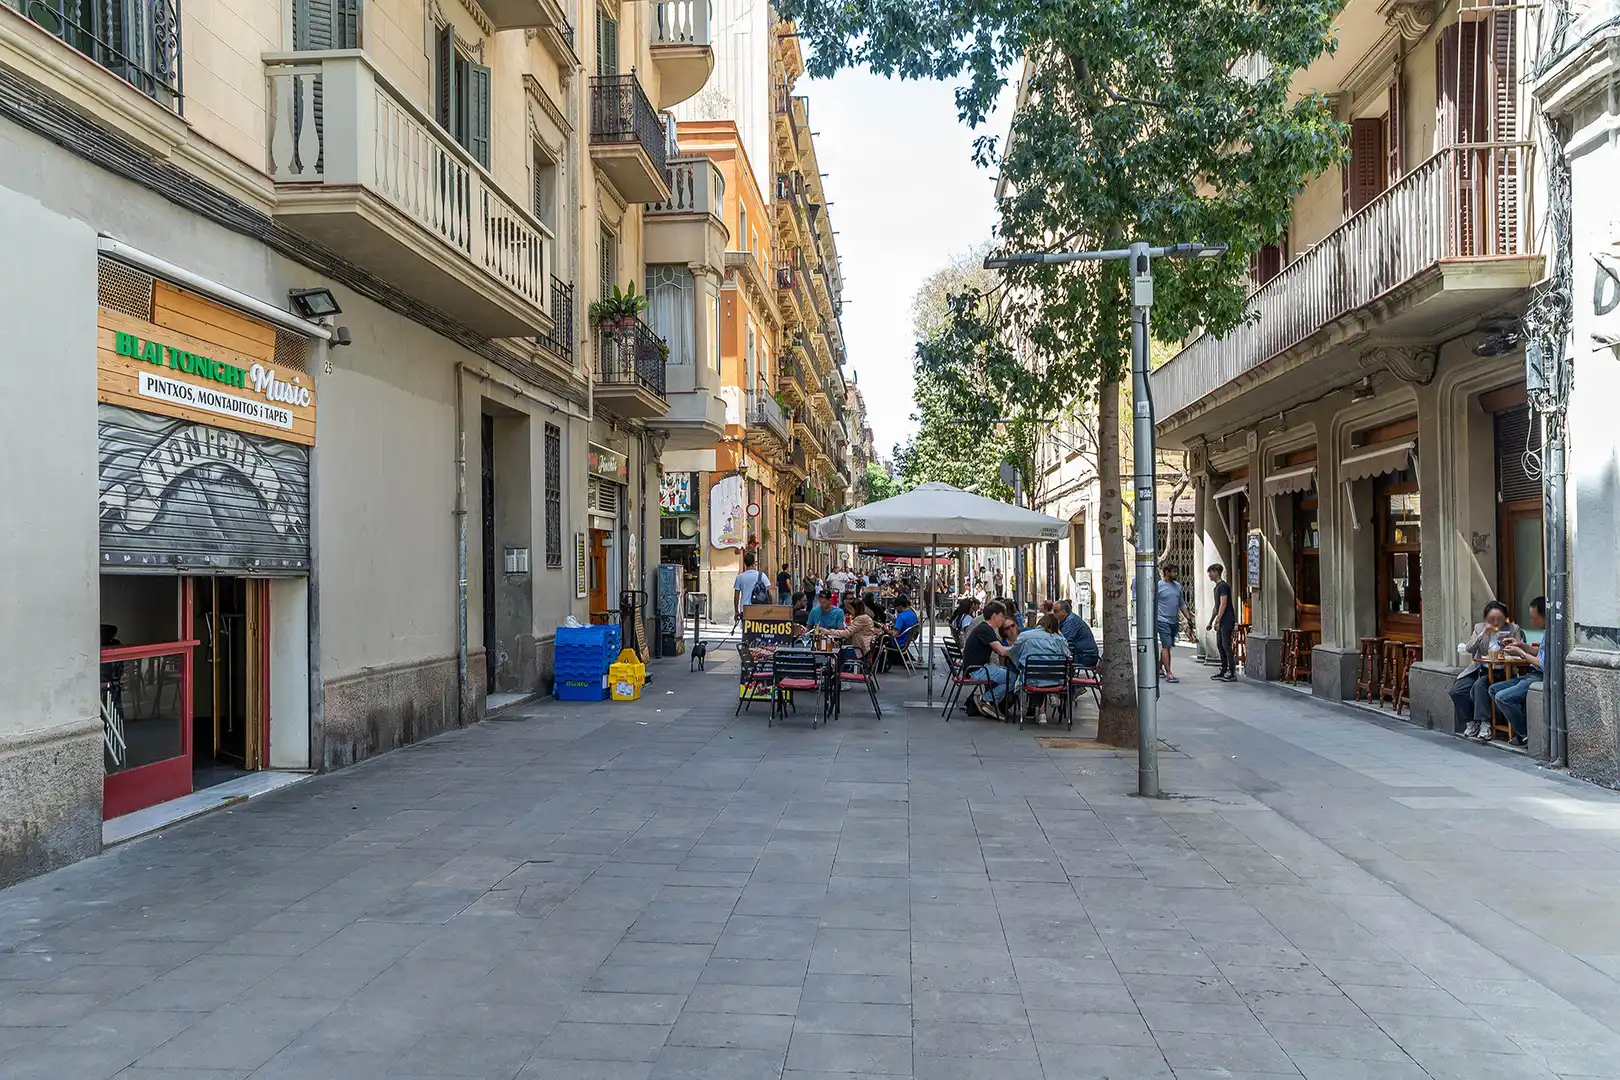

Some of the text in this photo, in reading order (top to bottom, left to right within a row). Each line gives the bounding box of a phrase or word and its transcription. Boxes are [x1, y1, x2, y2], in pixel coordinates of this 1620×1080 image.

[115, 330, 310, 408] BLAI TONIGHT Music
[325, 360, 333, 374] 25
[147, 376, 196, 404] PINTXOS,
[197, 390, 258, 416] MONTADITOS
[264, 406, 288, 424] TAPES
[744, 619, 792, 635] PINCHOS
